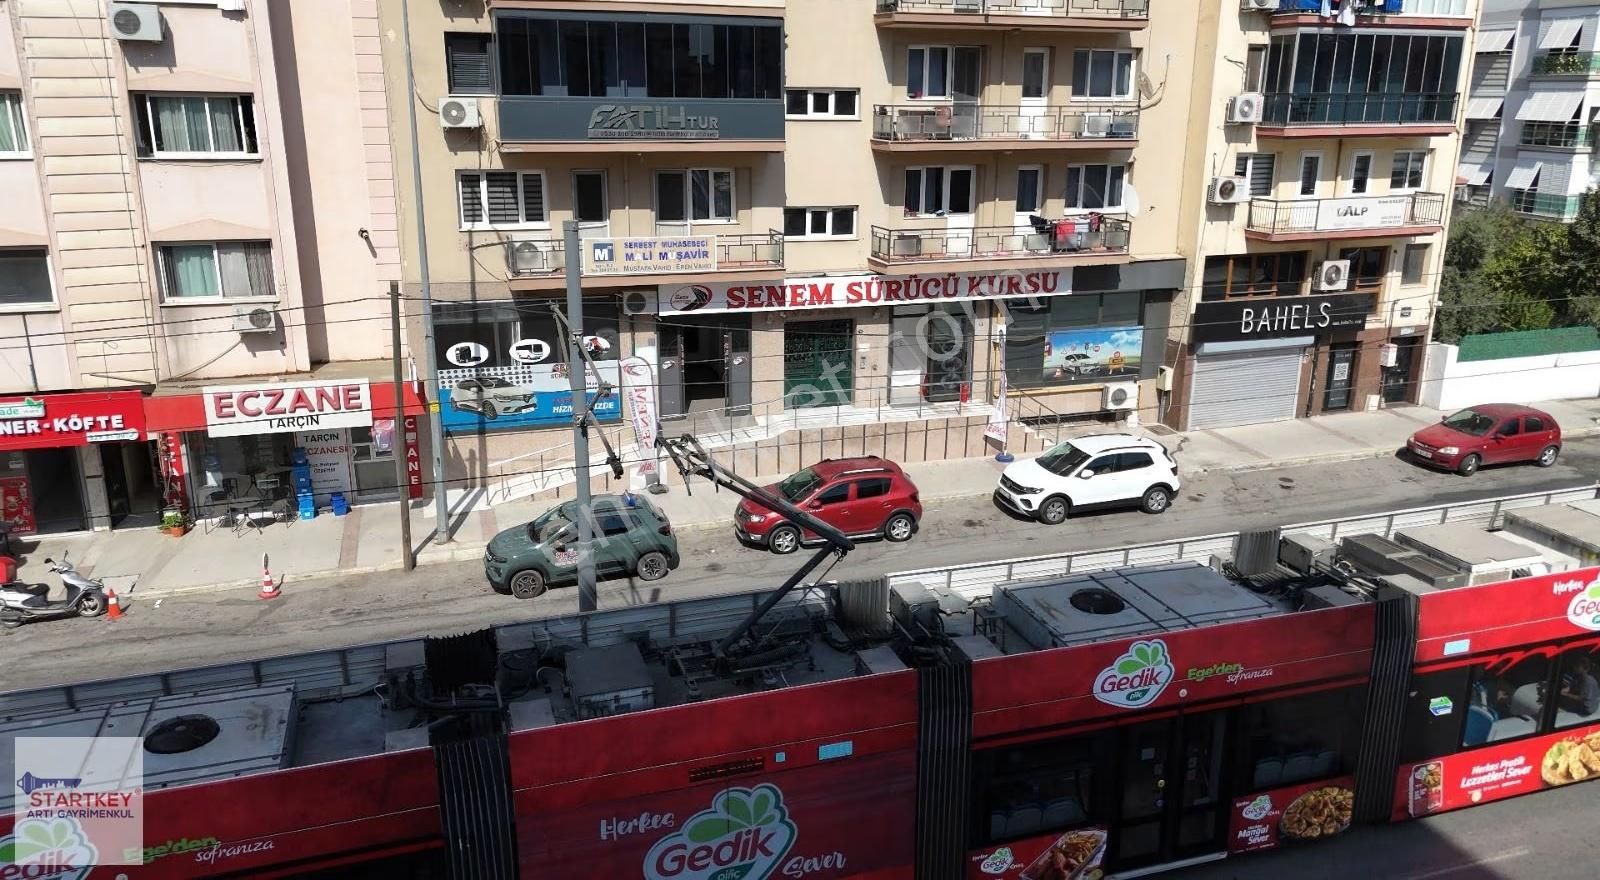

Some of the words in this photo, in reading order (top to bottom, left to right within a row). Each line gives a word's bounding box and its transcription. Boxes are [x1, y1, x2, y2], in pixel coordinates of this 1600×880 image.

[727, 283, 835, 310] SENEM
[846, 273, 961, 304] SÜRÜCÜ
[968, 271, 1060, 297] KURSU
[1241, 302, 1331, 334] BAHELS
[213, 384, 363, 418] ECZANE
[268, 415, 320, 429] TARÇIN
[1101, 667, 1163, 694] Gedik
[600, 812, 675, 841] Herkes
[655, 827, 778, 877] Gedik
[783, 852, 847, 878] Sever
